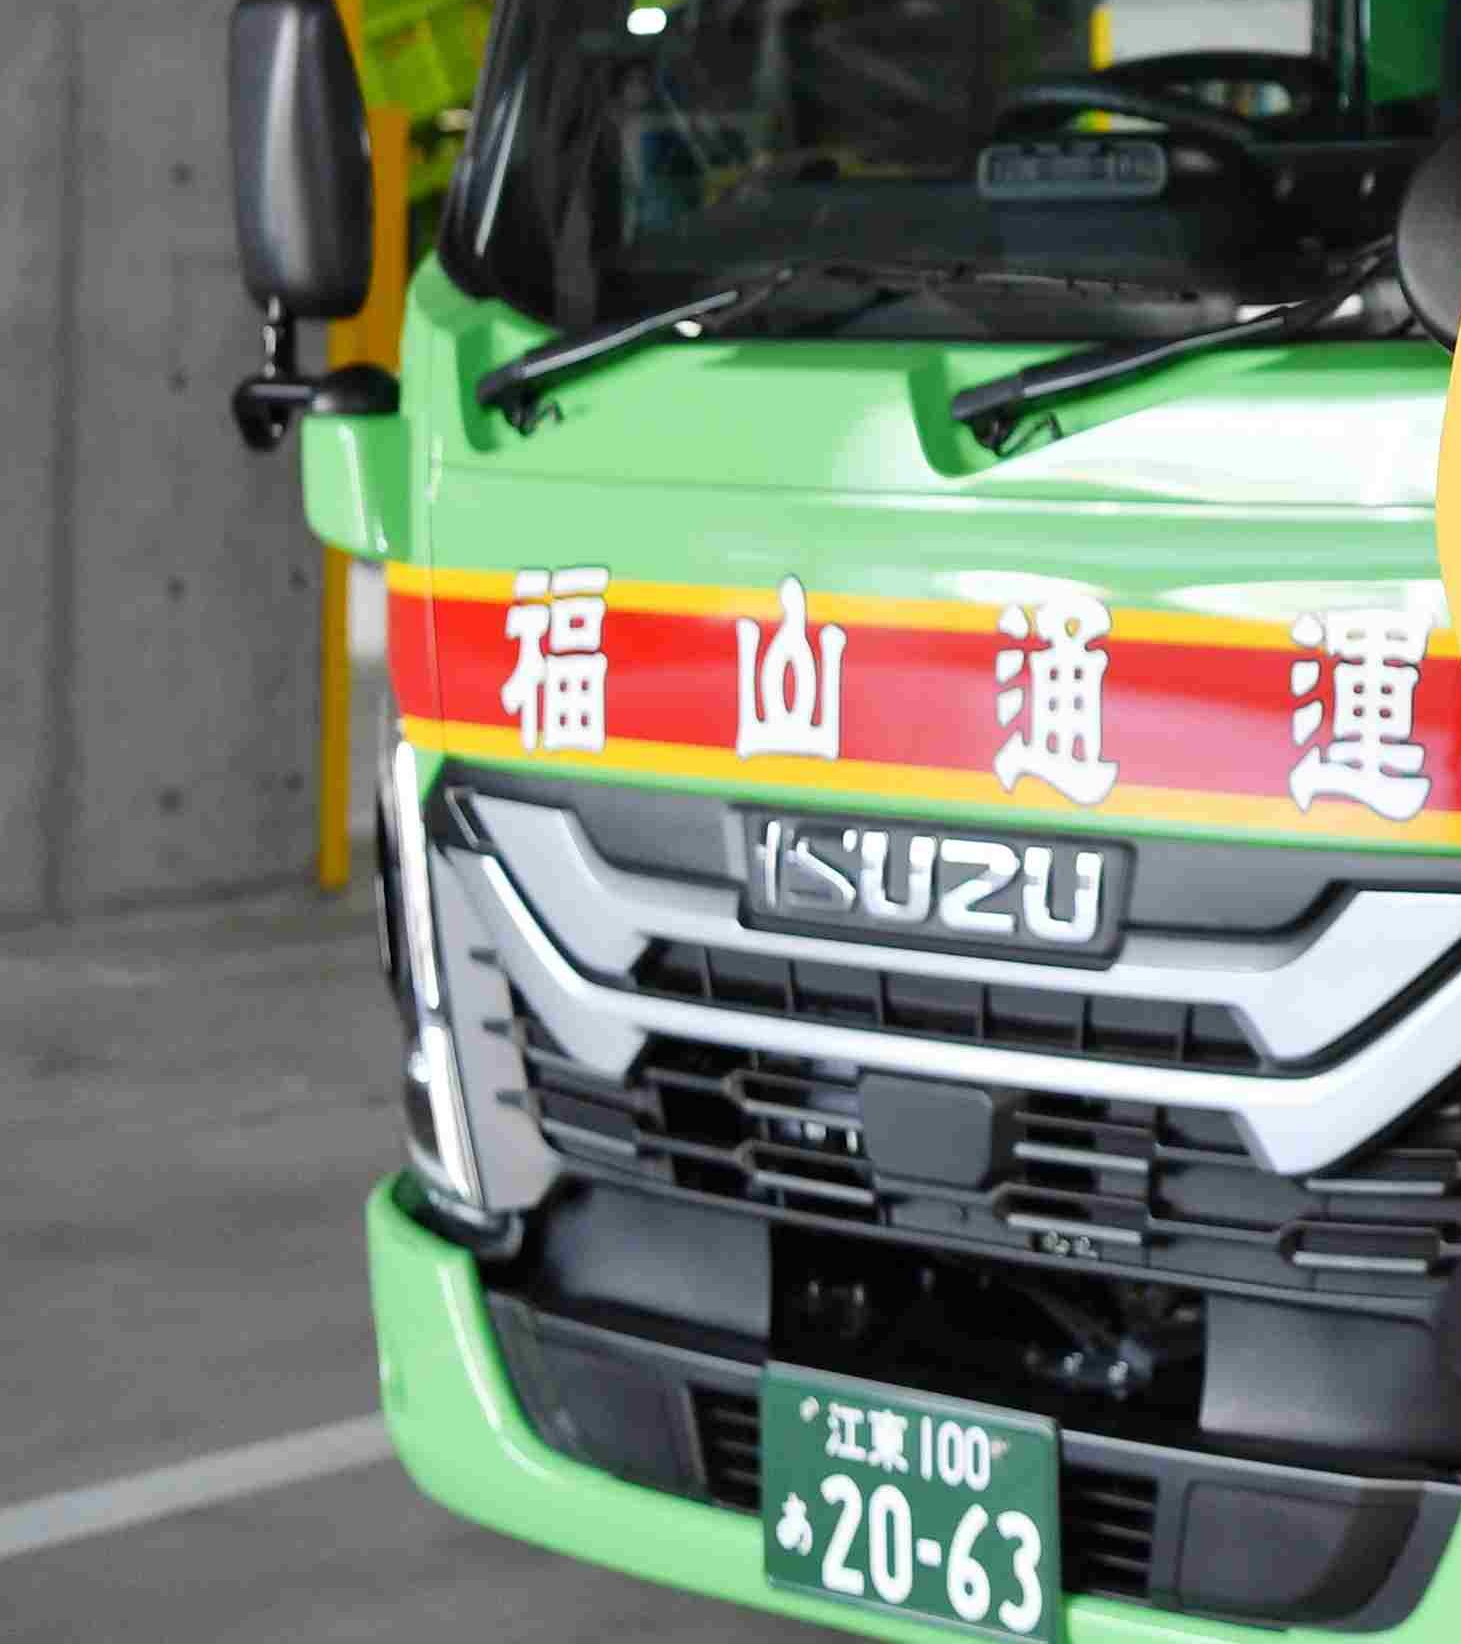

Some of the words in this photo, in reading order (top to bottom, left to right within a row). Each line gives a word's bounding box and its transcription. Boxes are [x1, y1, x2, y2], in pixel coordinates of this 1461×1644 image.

[501, 566, 1432, 821] 福山通運
[757, 820, 1104, 944] ISUZU
[826, 1402, 909, 1473] 江東
[920, 1416, 991, 1491] 100
[776, 1492, 813, 1556] あ
[820, 1474, 1043, 1634] 20-63
